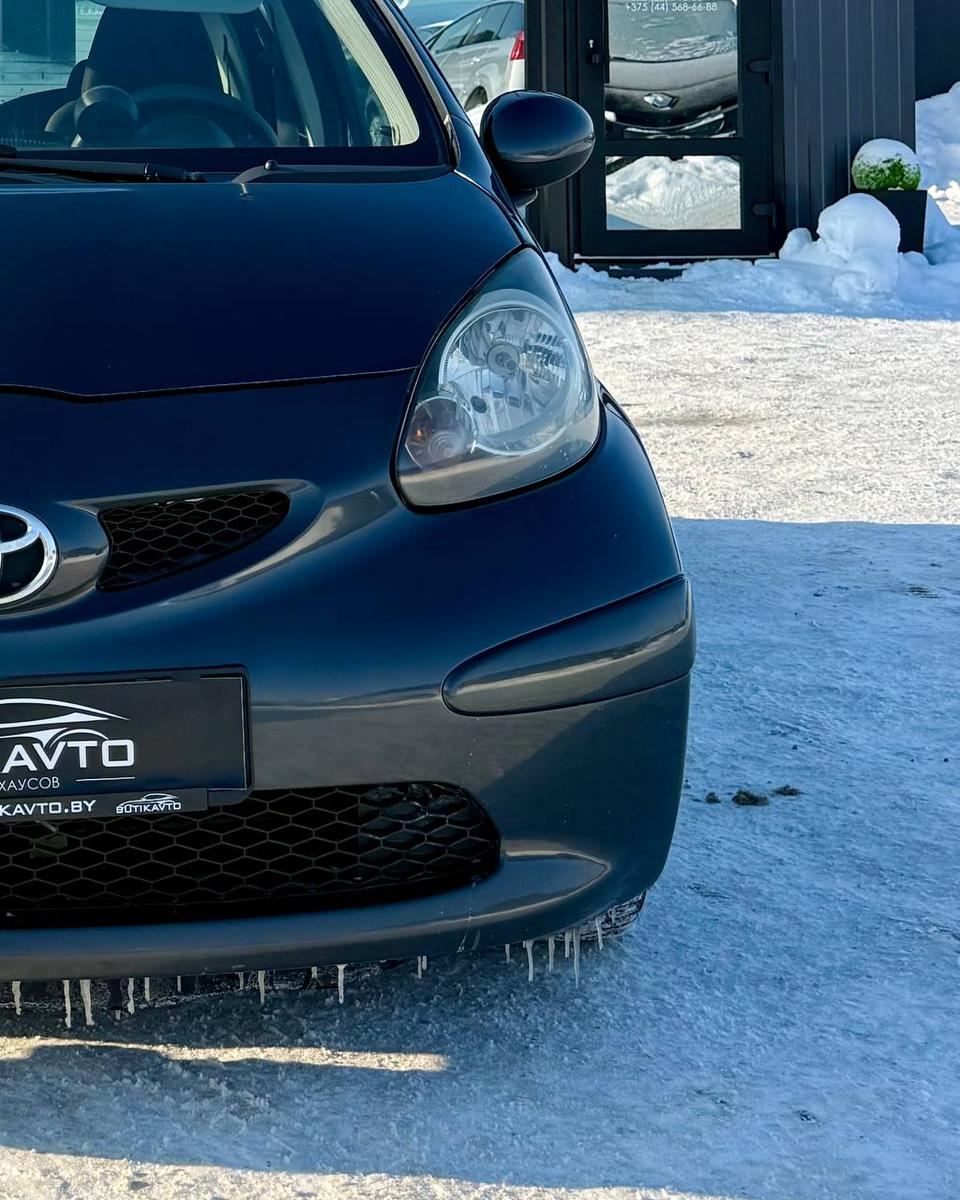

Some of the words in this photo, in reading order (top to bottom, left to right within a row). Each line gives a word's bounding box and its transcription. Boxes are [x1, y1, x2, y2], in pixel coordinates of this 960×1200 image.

[625, 2, 648, 12] +375
[651, 2, 669, 13] (44)
[671, 2, 718, 12] 568-66-88
[115, 801, 182, 814] BUTIKAVTO
